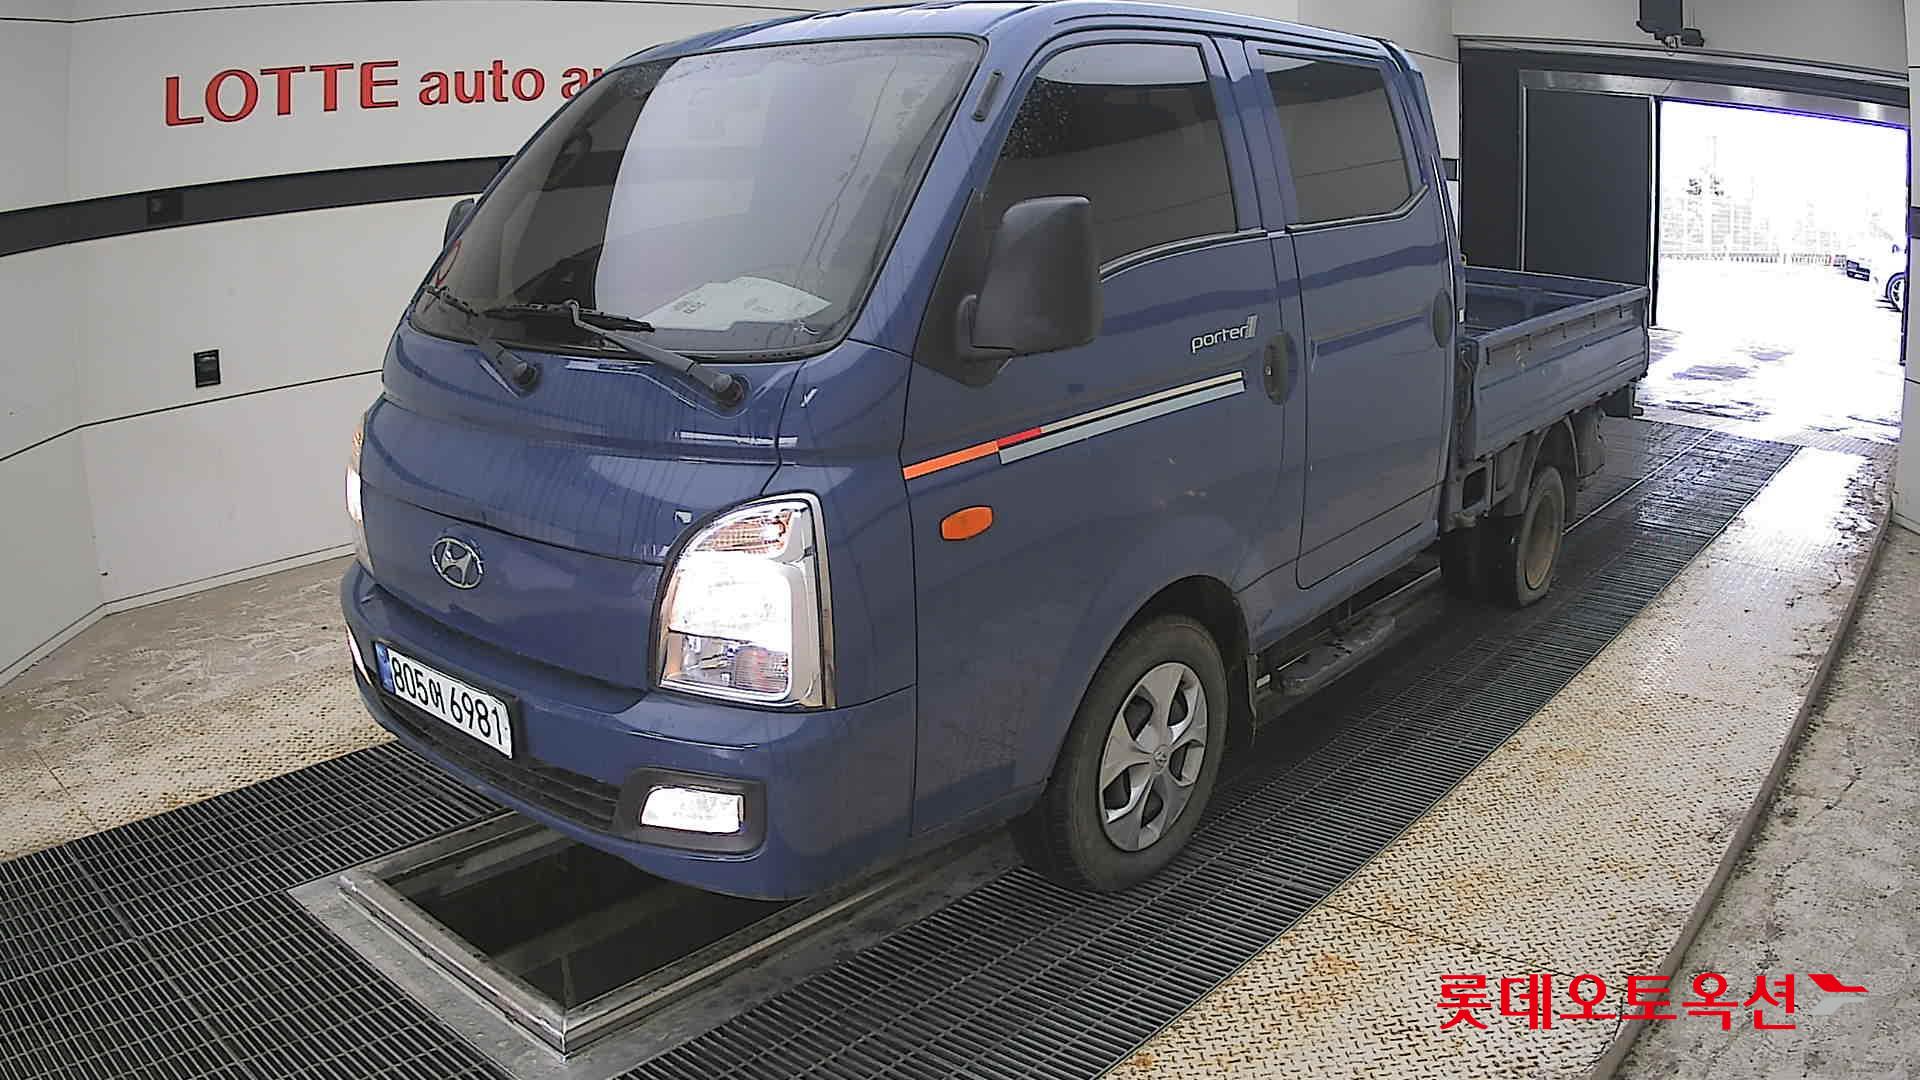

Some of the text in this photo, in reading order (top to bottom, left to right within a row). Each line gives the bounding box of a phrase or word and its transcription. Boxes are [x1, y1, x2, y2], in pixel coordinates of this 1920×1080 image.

[164, 60, 604, 126] LOTTE auto a
[391, 656, 503, 745] 805어 6981
